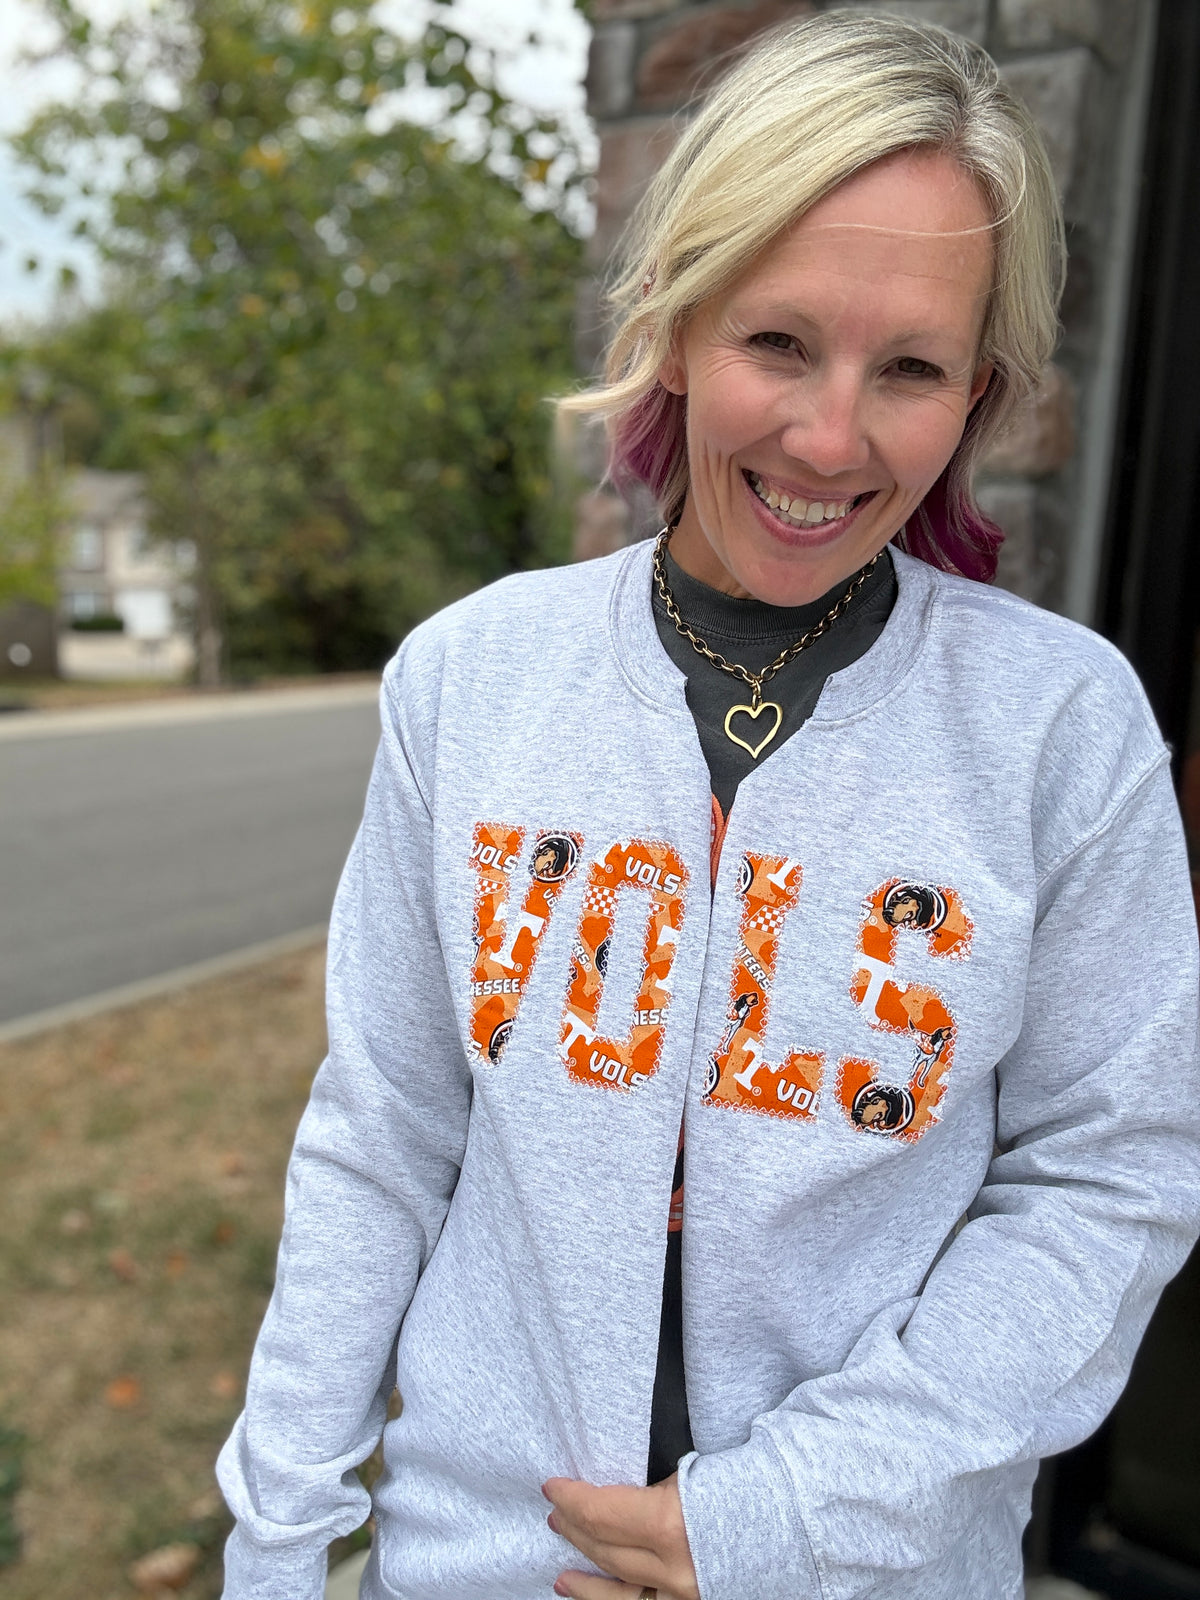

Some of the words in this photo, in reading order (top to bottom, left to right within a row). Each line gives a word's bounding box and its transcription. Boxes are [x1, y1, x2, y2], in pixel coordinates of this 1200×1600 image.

[624, 855, 682, 896] VOLS
[469, 819, 975, 1145] VOLS
[471, 977, 521, 996] ESSEE
